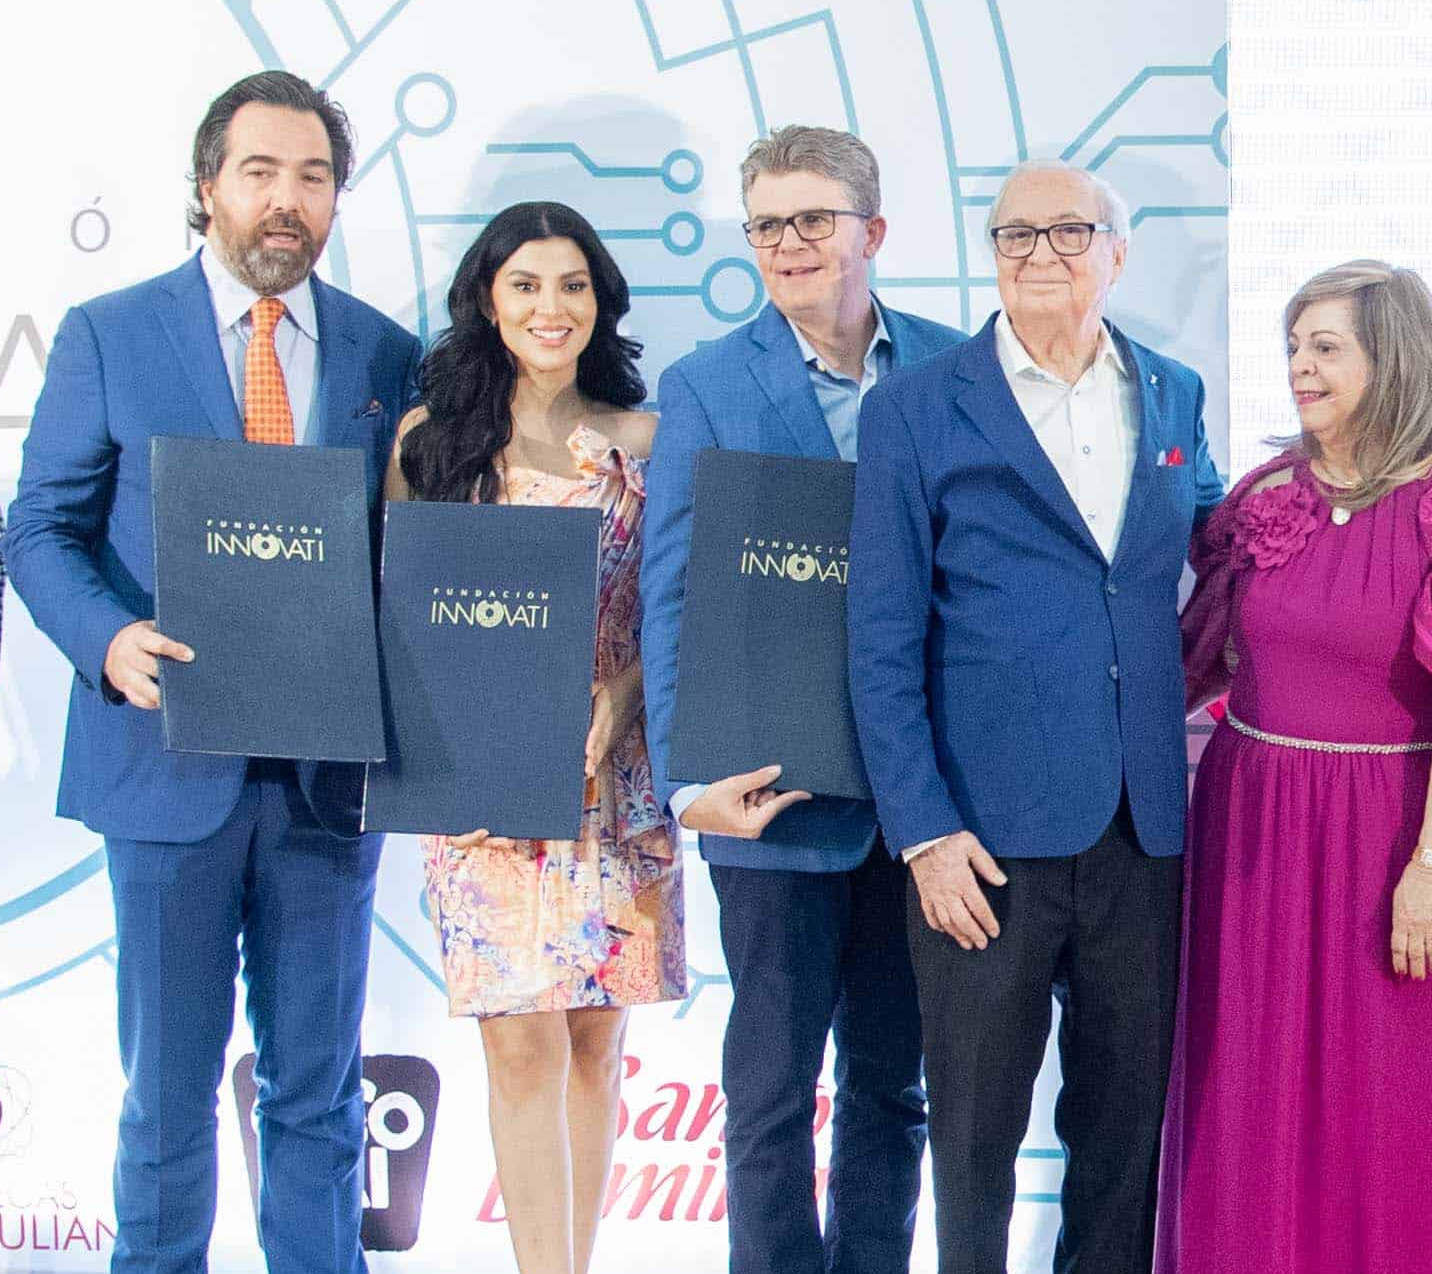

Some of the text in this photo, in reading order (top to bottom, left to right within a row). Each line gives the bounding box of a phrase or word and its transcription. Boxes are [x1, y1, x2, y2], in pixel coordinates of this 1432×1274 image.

[206, 519, 323, 534] FUNDACIÓN
[206, 532, 324, 562] INNOVATI
[743, 537, 848, 556] FUNDACIÓ
[741, 551, 849, 585] INNOVAT
[433, 587, 550, 600] FUNDACIÓN
[430, 600, 549, 630] INNOVATI
